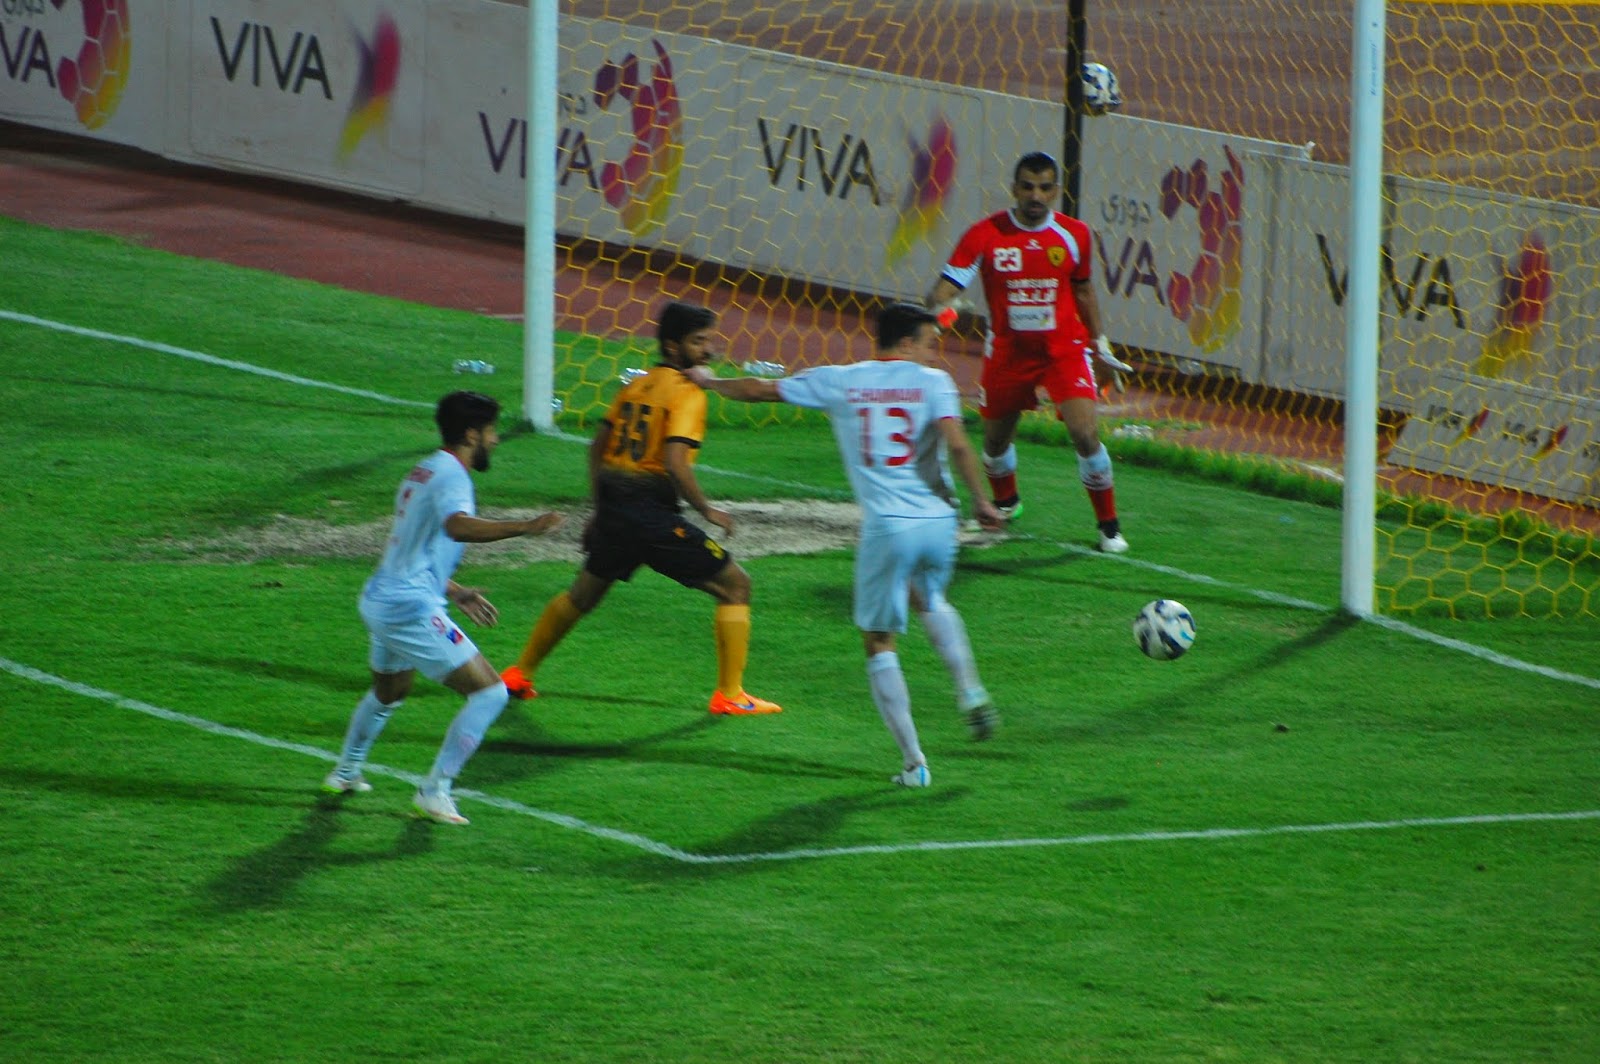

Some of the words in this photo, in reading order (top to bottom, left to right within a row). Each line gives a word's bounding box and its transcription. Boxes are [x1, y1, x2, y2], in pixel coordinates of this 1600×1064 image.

[210, 16, 333, 100] VIVA
[758, 118, 881, 207] VIVA
[992, 247, 1023, 272] 23
[1316, 233, 1465, 329] VVA
[857, 407, 914, 468] 13
